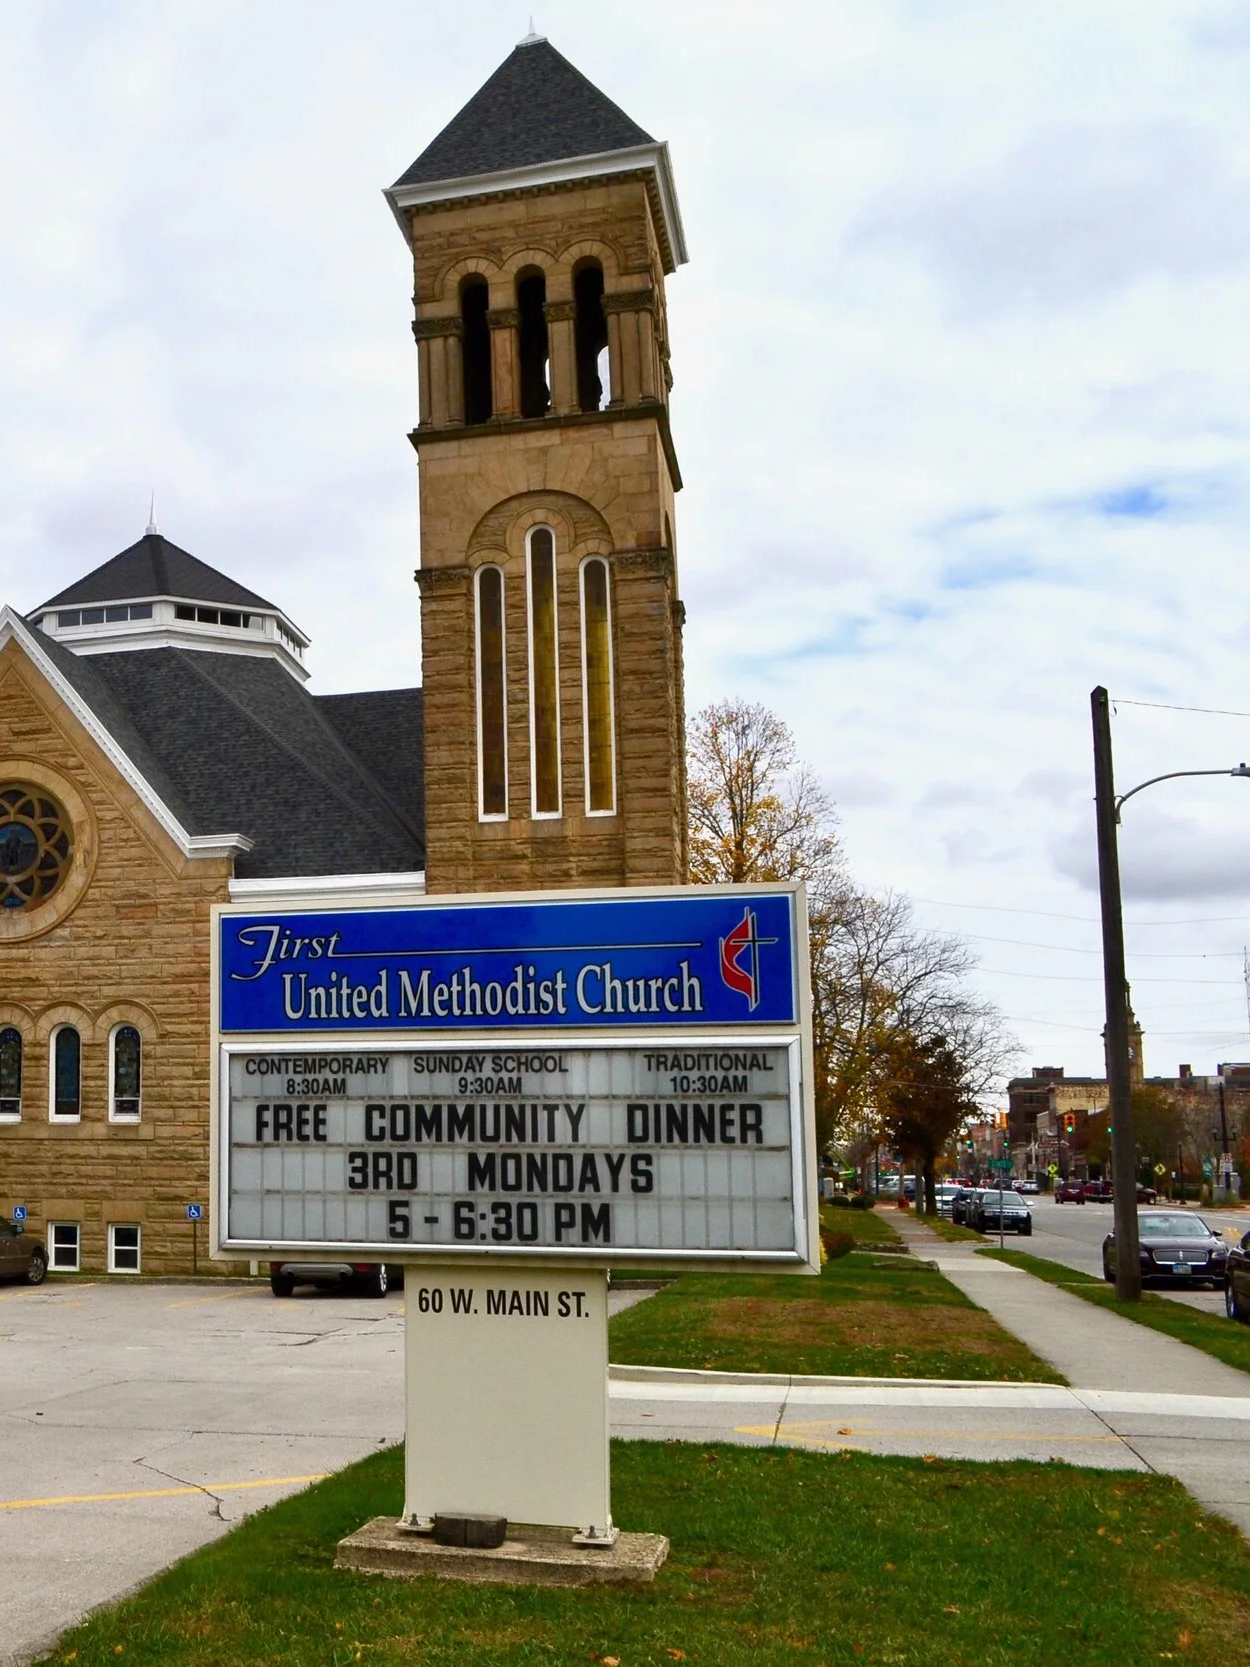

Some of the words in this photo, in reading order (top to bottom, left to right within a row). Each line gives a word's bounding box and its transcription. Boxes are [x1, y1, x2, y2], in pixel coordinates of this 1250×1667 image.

[231, 924, 344, 980] First
[281, 969, 389, 1020] United
[398, 964, 567, 1018] Methodist
[576, 959, 703, 1015] Church
[245, 1056, 389, 1075] CONTEMPORARY
[413, 1055, 485, 1074] SUNDAY
[491, 1054, 568, 1074] SCHOOL
[644, 1053, 774, 1072] TRADITIONAL
[286, 1077, 347, 1096] 8:30AM
[458, 1076, 523, 1095] 9:30AM
[669, 1074, 748, 1094] 10:30AM
[255, 1103, 328, 1142] FREE
[364, 1103, 586, 1143] COMMUNITY
[627, 1102, 764, 1144] DINNER
[348, 1151, 419, 1190] 3RD
[466, 1151, 654, 1193] MONDAYS
[388, 1199, 410, 1239] 5
[452, 1200, 539, 1241] 6:30
[554, 1202, 612, 1243] PM
[418, 1287, 444, 1314] 60
[449, 1287, 479, 1314] W.
[485, 1288, 549, 1317] MAIN
[557, 1290, 591, 1318] ST.
